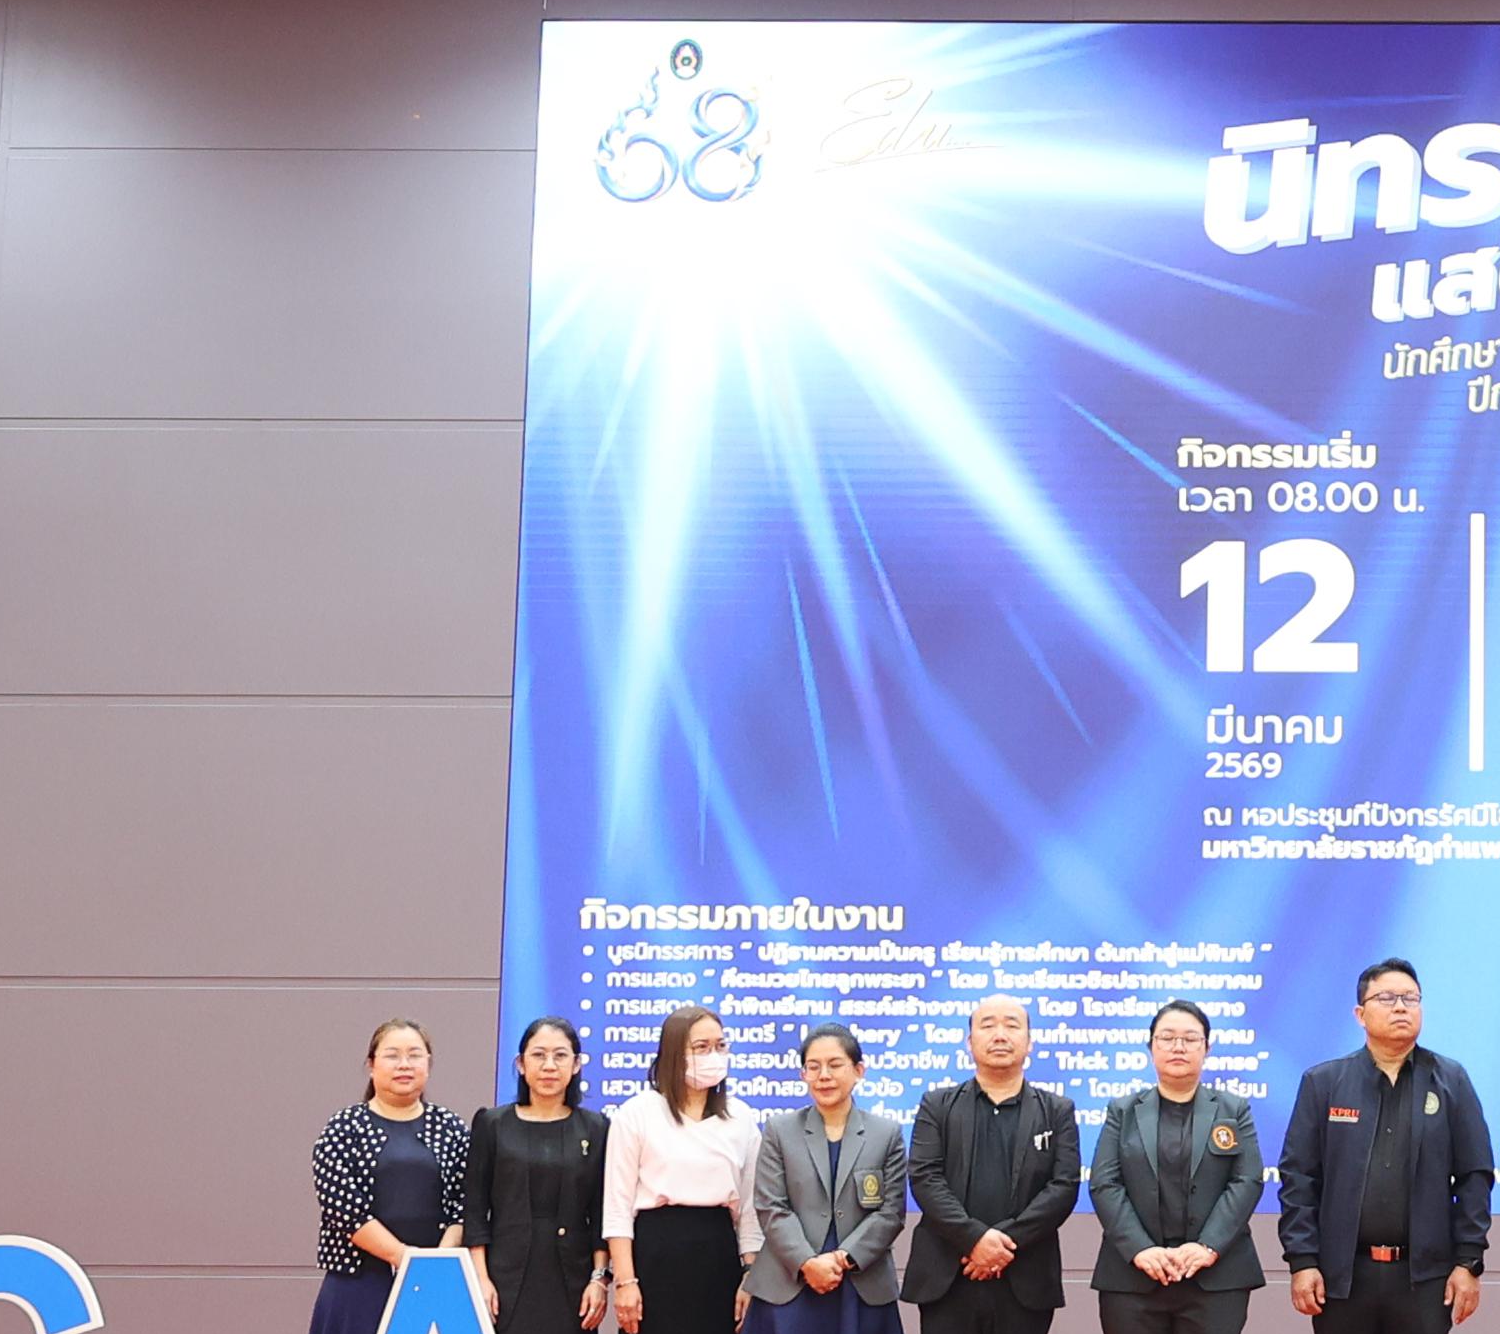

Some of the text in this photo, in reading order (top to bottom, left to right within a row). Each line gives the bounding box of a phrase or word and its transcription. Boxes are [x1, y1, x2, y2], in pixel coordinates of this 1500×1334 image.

[1177, 430, 1377, 468] กิจกรรมเริ่ม
[1178, 481, 1425, 512] เวลา 08.00 น.
[1179, 538, 1359, 673] 12
[1206, 704, 1343, 744] มีนาคม
[1205, 752, 1283, 779] 2569
[1203, 806, 1232, 827] ณ
[580, 897, 903, 931] กิจกรรมภายในงาน
[607, 942, 734, 966] บูธนิทรรศการ
[606, 970, 697, 988] การแสดง
[949, 969, 989, 989] โดย
[1037, 997, 1077, 1017] โดย
[923, 1023, 964, 1044] โดย
[1055, 1052, 1109, 1070] Trick
[1115, 1052, 1148, 1070] DD
